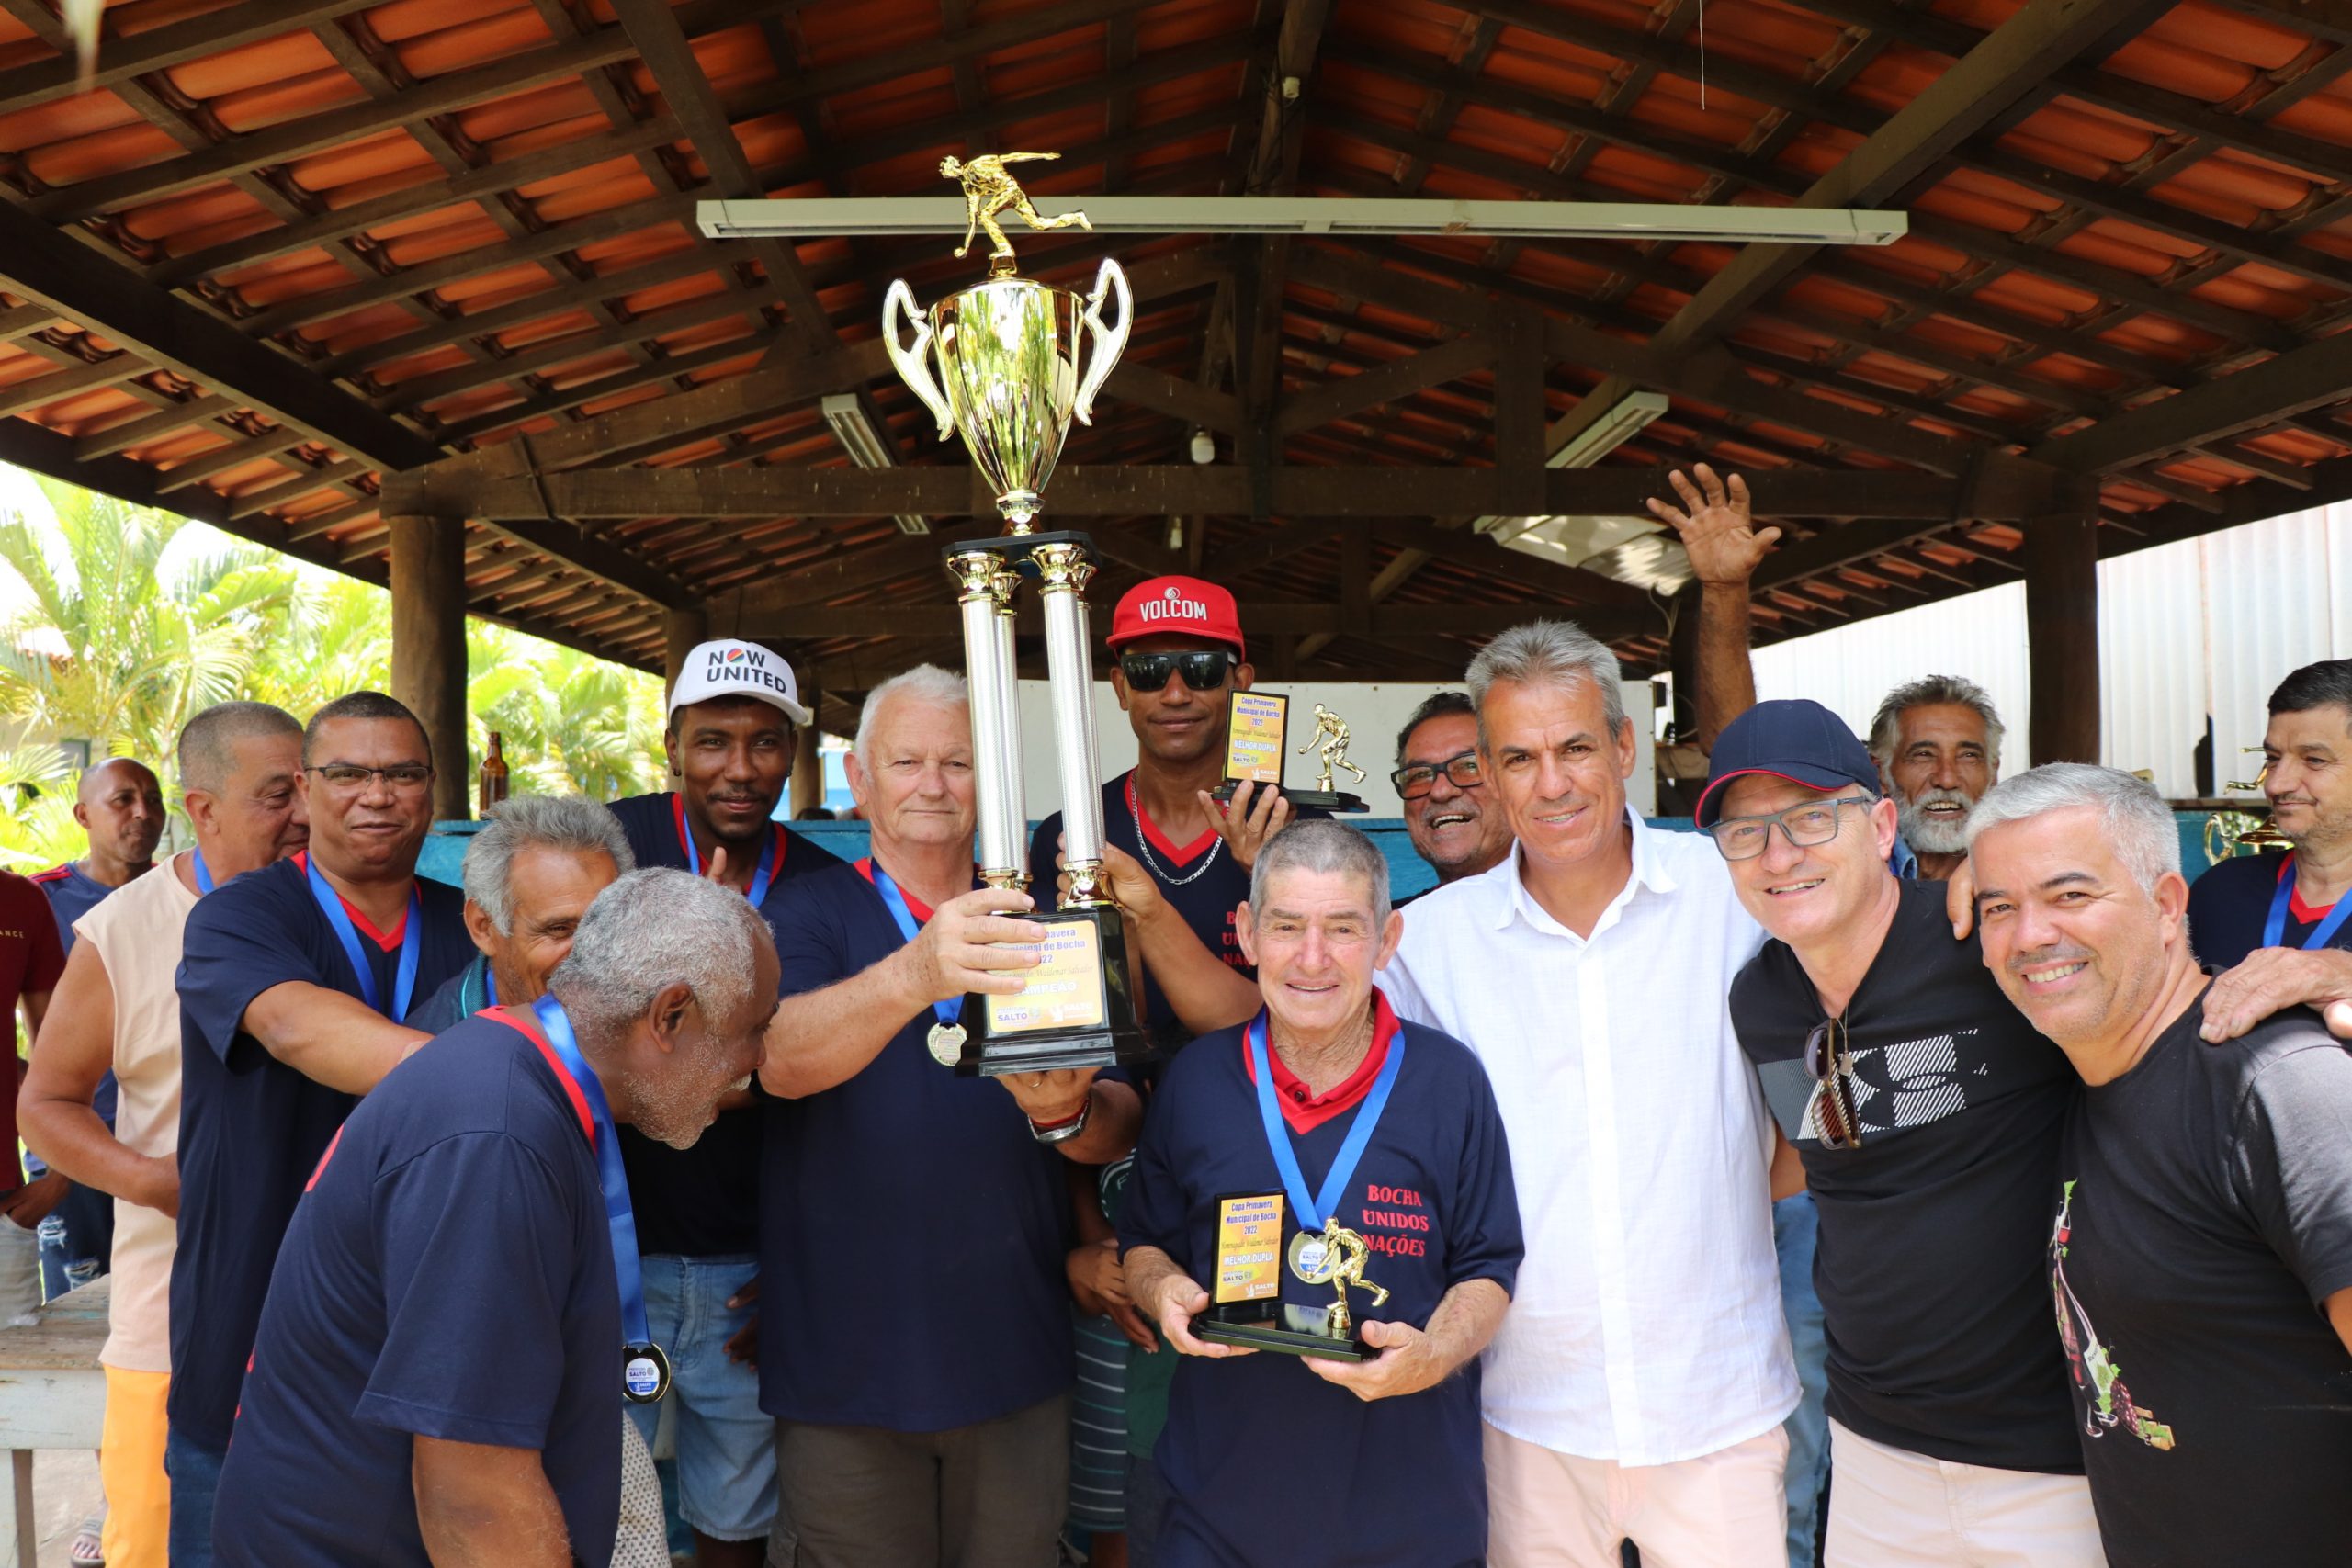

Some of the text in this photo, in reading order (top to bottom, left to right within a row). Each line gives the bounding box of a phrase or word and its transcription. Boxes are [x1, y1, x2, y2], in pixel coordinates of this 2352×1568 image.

[1139, 599, 1207, 622] VOLCOM
[708, 648, 765, 667] NOW
[707, 666, 786, 694] UNITED
[1044, 942, 1055, 952] de
[1057, 940, 1086, 950] Bocha
[1014, 980, 1078, 996] AMPEÃO
[998, 1012, 1028, 1021] SALTO
[1367, 1184, 1422, 1207] BOCHA
[1232, 1201, 1272, 1212] Copa Primavera
[1226, 1212, 1277, 1224] Municipal de Bocha
[1363, 1209, 1429, 1232] UNIDOS
[1244, 1225, 1257, 1235] 2022
[1362, 1233, 1425, 1258] NAÇÕES
[1224, 1252, 1273, 1266] MELHOR DUPLA
